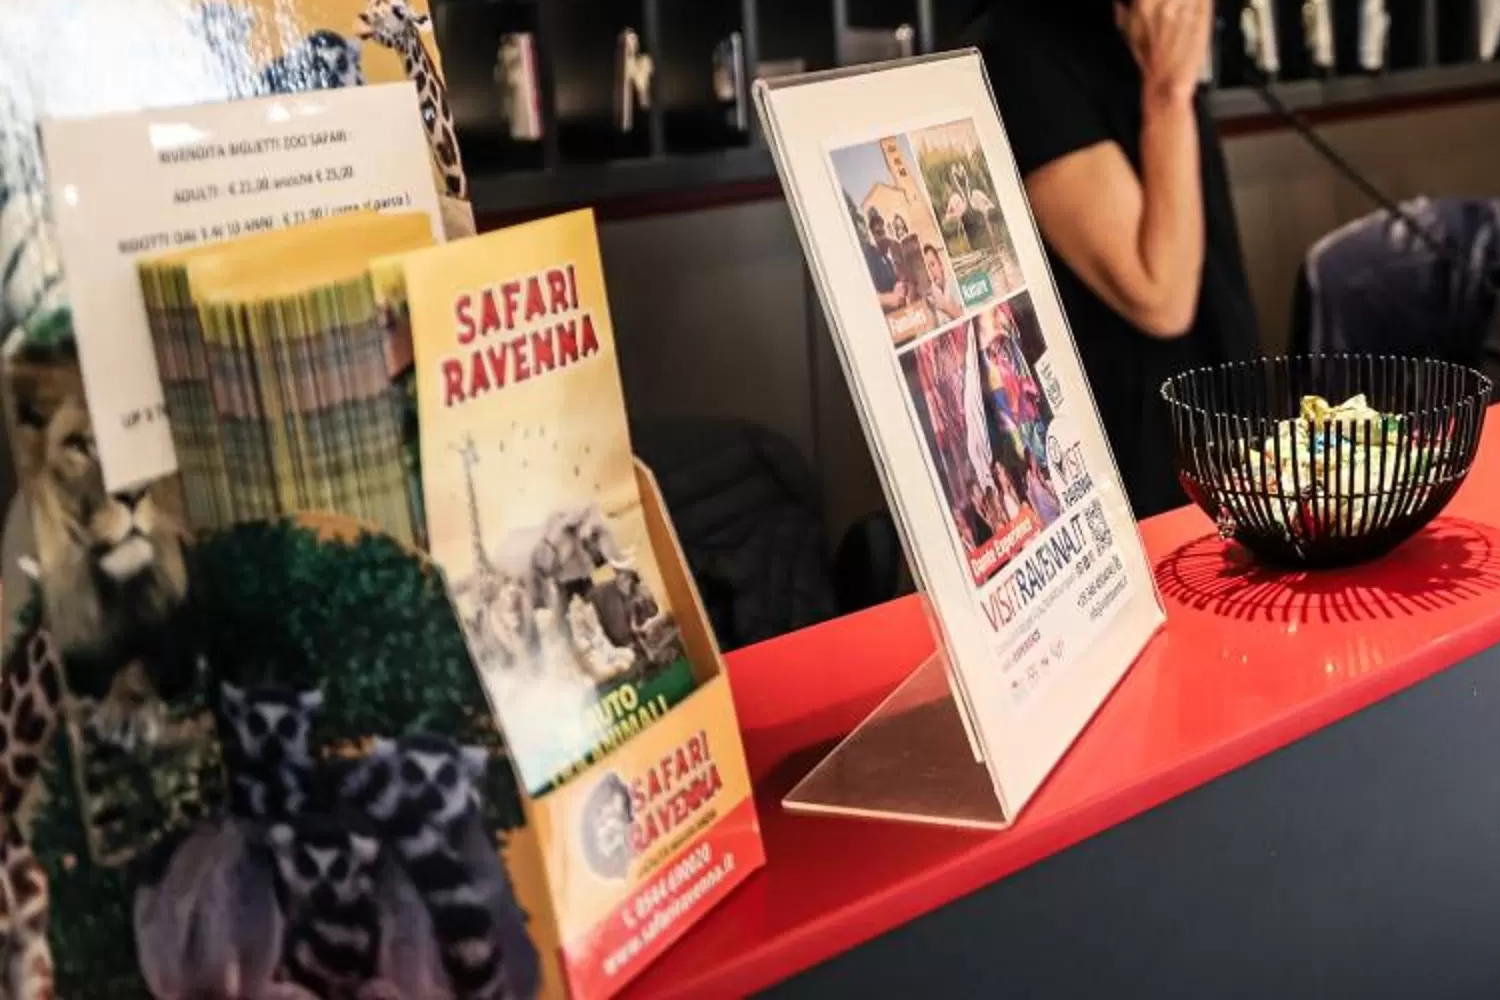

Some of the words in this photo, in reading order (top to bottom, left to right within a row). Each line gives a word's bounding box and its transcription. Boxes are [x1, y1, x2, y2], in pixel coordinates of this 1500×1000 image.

[455, 263, 579, 345] SAFARI
[441, 313, 600, 407] RAVENNA
[630, 763, 723, 850] RAVENNA
[632, 729, 711, 811] SAFARI
